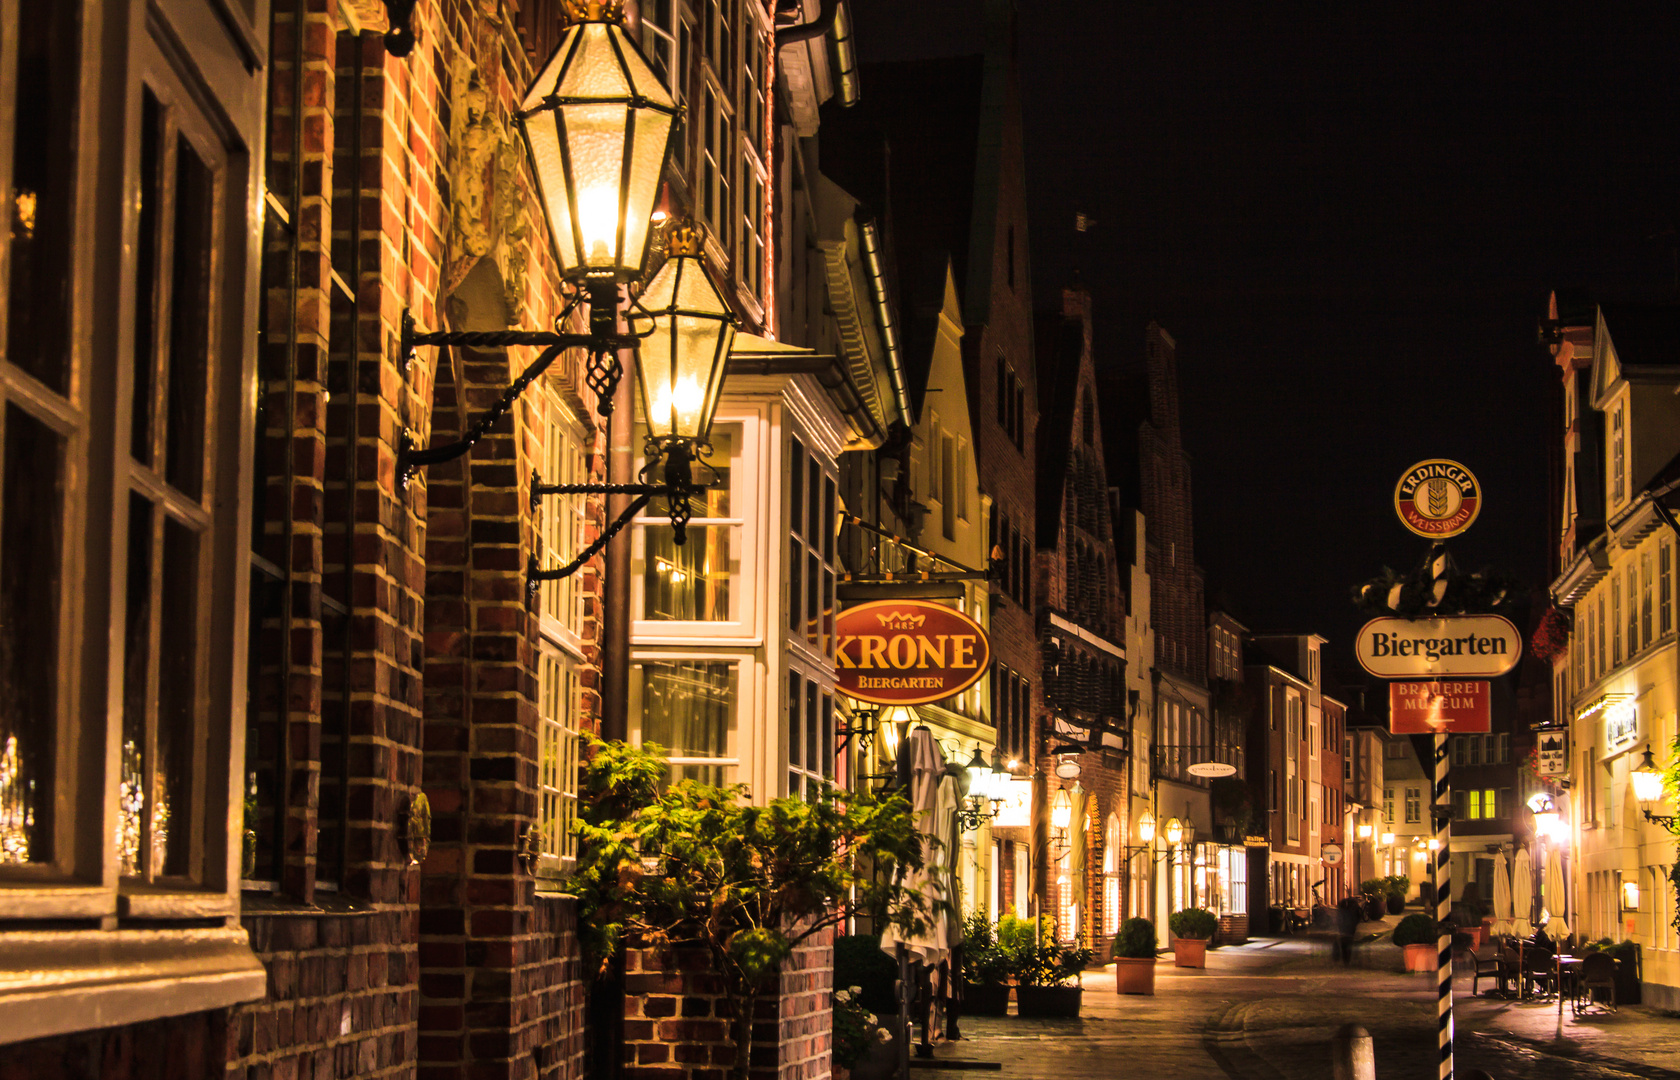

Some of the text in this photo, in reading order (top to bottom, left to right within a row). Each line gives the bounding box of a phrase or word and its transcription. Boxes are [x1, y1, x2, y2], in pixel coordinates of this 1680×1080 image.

[1402, 465, 1473, 494] ERDINGER
[889, 622, 915, 630] 1485
[835, 634, 978, 670] KRONE
[1371, 632, 1507, 662] Biergarten
[858, 675, 944, 689] BIERGARTEN
[1399, 682, 1480, 695] BRAUEREI
